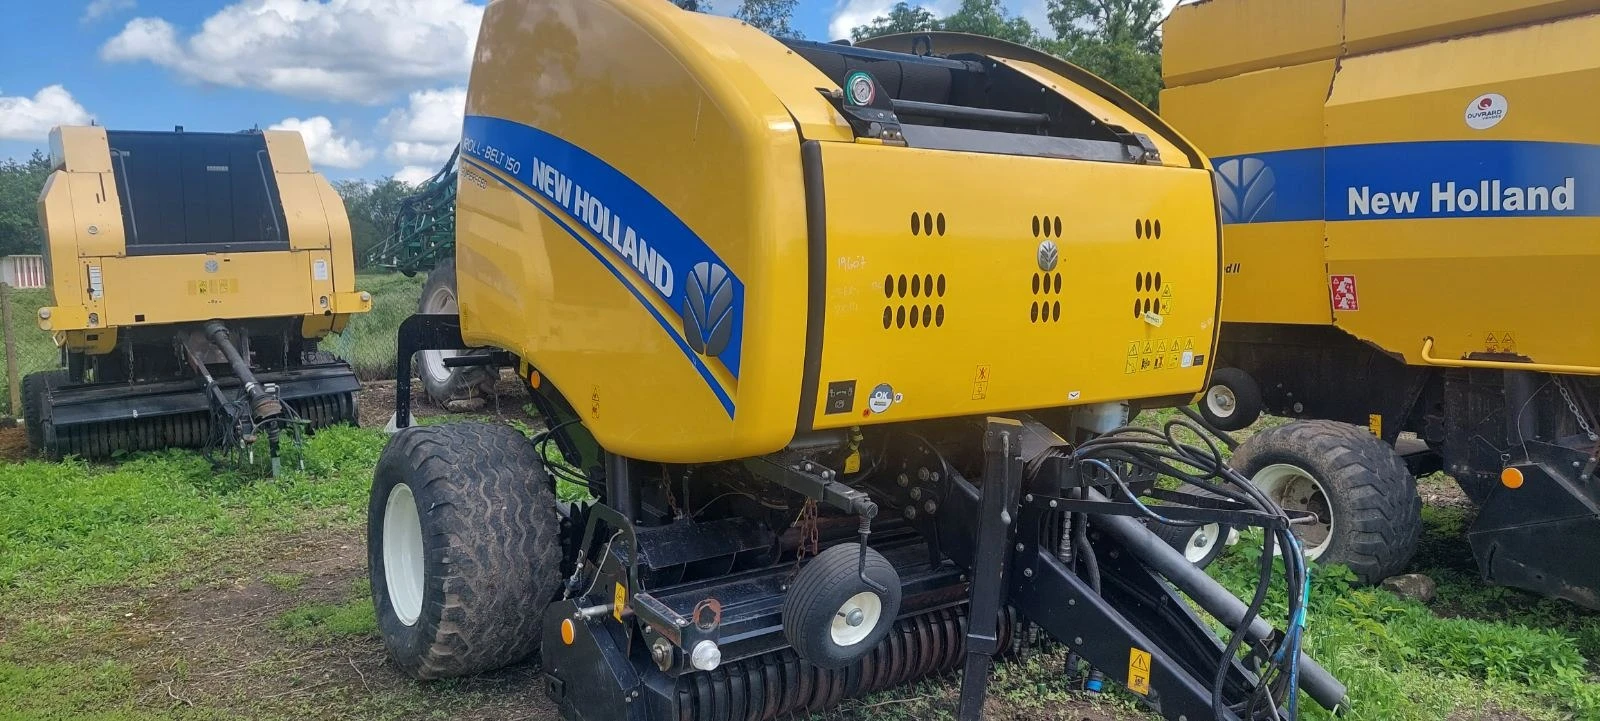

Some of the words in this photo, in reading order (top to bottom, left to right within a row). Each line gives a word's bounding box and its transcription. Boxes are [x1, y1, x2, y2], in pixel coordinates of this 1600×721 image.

[505, 155, 521, 175] 150
[1348, 186, 1420, 215] New
[1431, 177, 1575, 213] Holland
[532, 156, 572, 209] NEW
[574, 187, 674, 298] HOLLAND
[875, 391, 889, 400] OK
